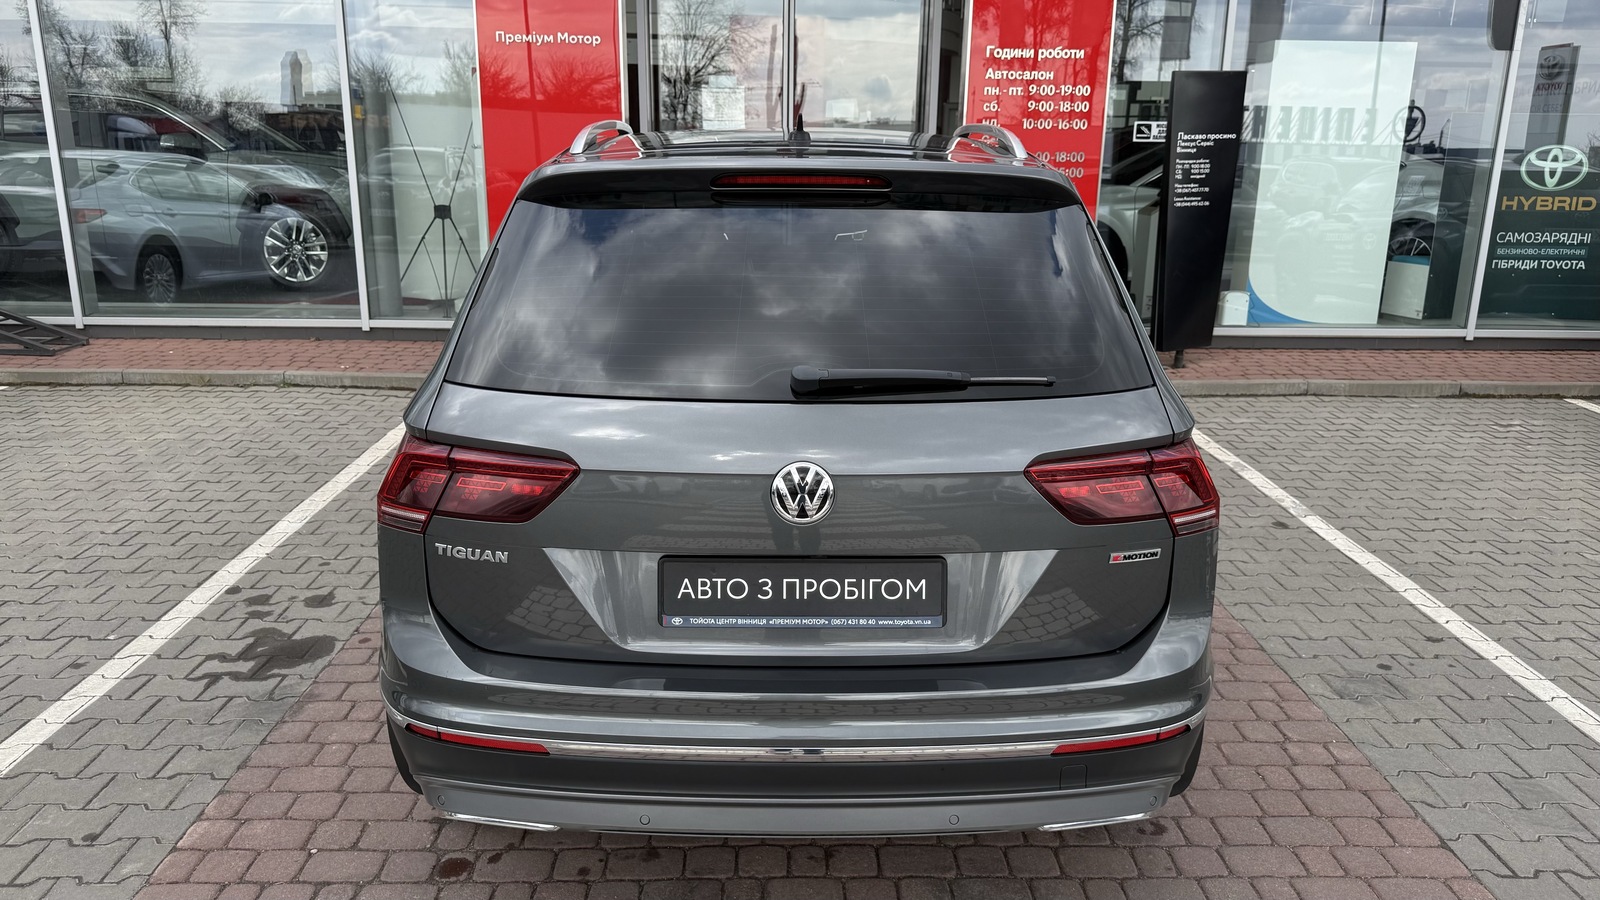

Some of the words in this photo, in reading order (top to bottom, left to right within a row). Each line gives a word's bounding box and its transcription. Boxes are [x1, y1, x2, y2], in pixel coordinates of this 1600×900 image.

[495, 31, 554, 46] Преміум
[557, 32, 601, 47] Мотор
[986, 45, 1034, 60] Години
[1038, 46, 1085, 61] роботи
[985, 68, 1054, 80] Автосалон
[1028, 85, 1091, 97] 9:00-19:00
[983, 101, 1000, 112] сб.
[1027, 101, 1090, 113] 9:00-18:00
[1022, 118, 1088, 130] 10:00-16:00
[1207, 133, 1237, 141] просимо
[1501, 196, 1597, 211] HYBRID
[1496, 232, 1592, 245] САМОЗАРЯДНІ
[1496, 247, 1586, 256] БЕНЗИНОВО-ЕЛЕКТРИЧНІ
[1491, 259, 1538, 270] ГІБРИДИ
[1540, 260, 1586, 270] TOYOTA
[434, 542, 509, 563] TIGUAN
[677, 578, 749, 600] АВТО
[782, 578, 926, 600] ПРОБІГОМ
[689, 617, 716, 625] ТОЙОТА
[716, 618, 737, 626] ЦЕНТР
[737, 618, 767, 626] ВІННИЦЯ
[830, 618, 847, 626] (067)
